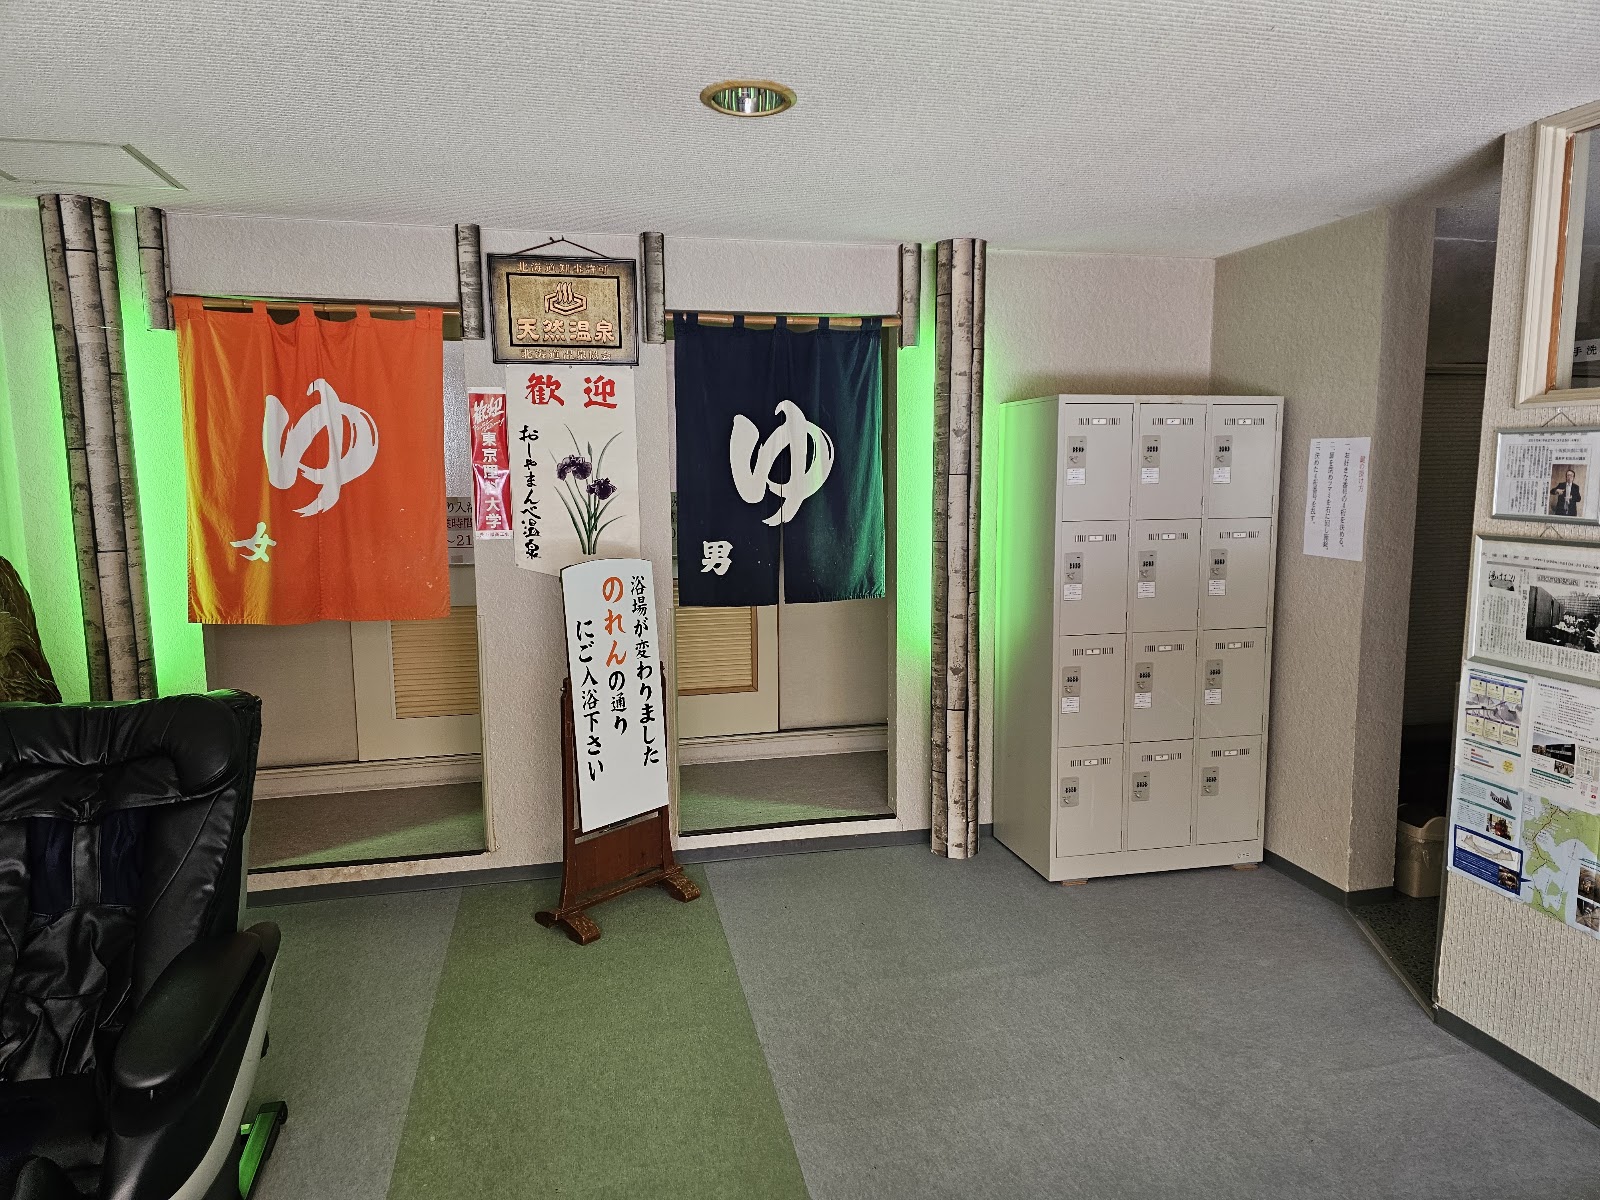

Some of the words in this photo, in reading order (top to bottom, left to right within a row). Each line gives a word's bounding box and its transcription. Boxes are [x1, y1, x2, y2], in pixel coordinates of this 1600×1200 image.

[516, 318, 615, 343] 天然温泉
[525, 373, 618, 409] 歓迎
[262, 378, 379, 518] ゆ
[729, 399, 835, 527] ゆ
[229, 521, 277, 563] 女
[701, 540, 733, 575] 男
[576, 620, 604, 782] にご入浴下さい
[602, 576, 628, 736] のれんの通り
[631, 575, 660, 767] 浴場が変わりました
